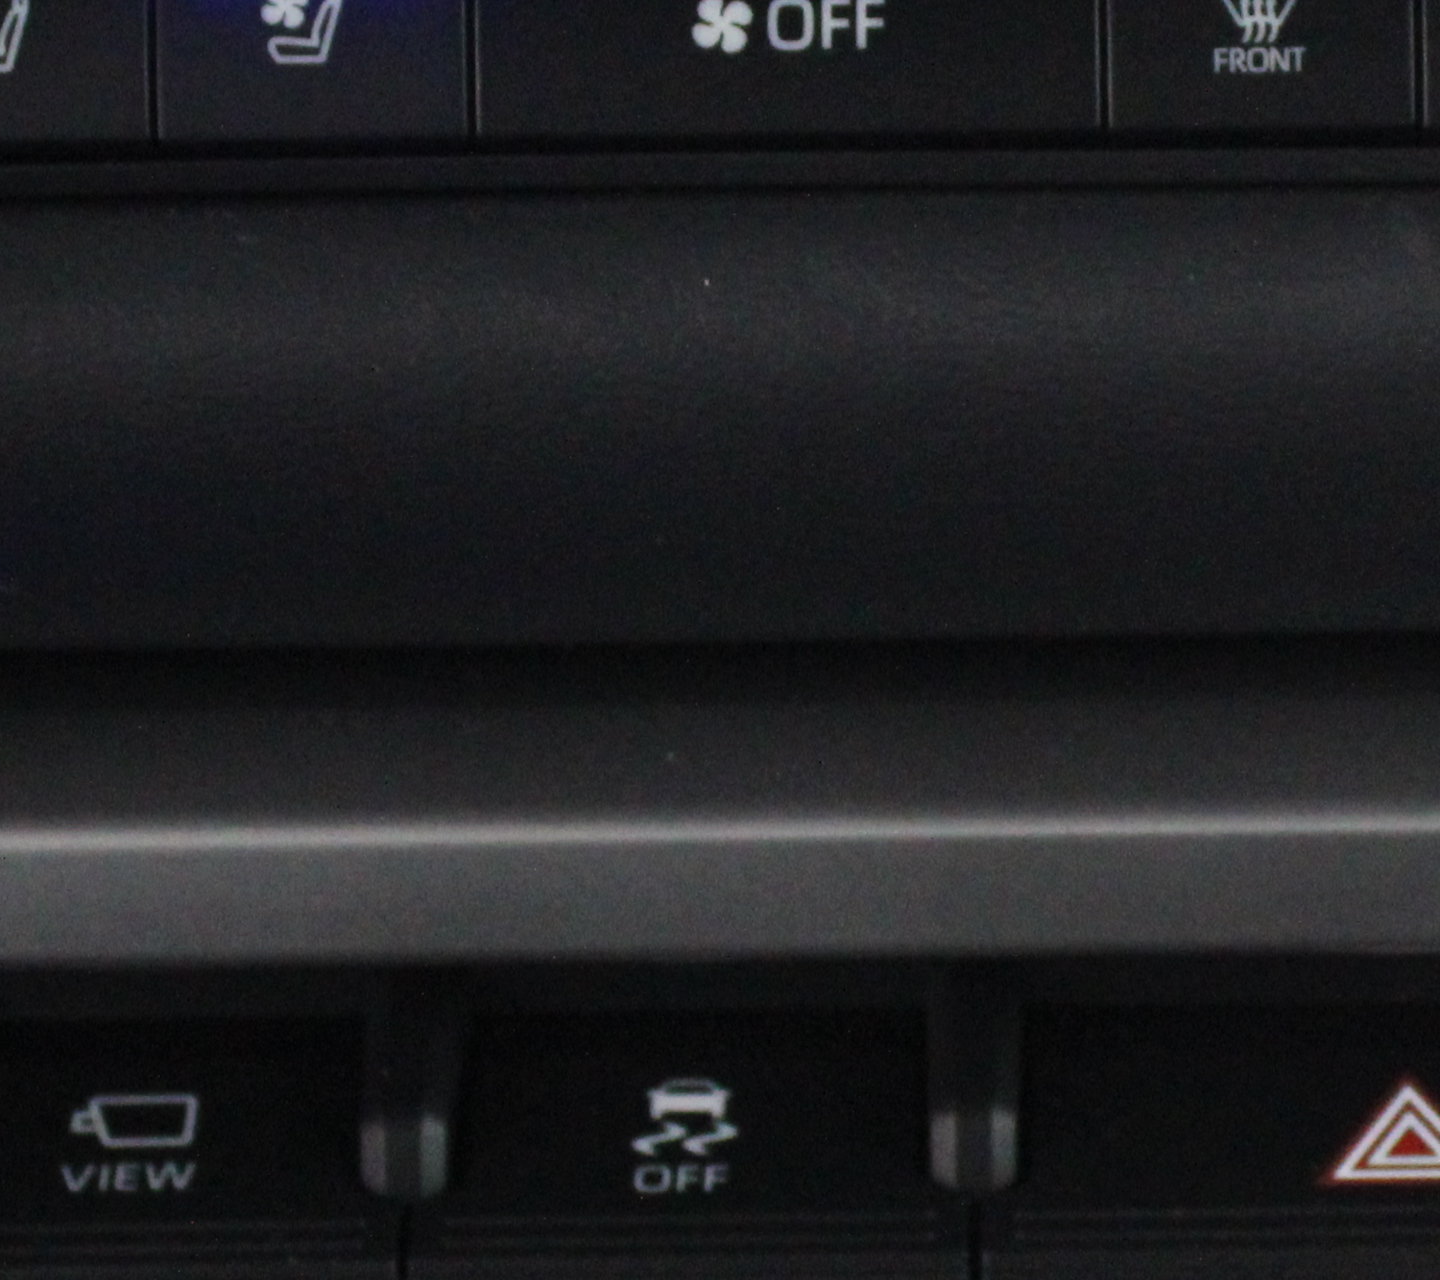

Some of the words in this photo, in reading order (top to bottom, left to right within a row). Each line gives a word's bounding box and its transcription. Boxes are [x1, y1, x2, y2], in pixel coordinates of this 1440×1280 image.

[1213, 46, 1306, 74] FRONT
[61, 1161, 197, 1193] VIEW
[633, 1164, 728, 1193] OFF
